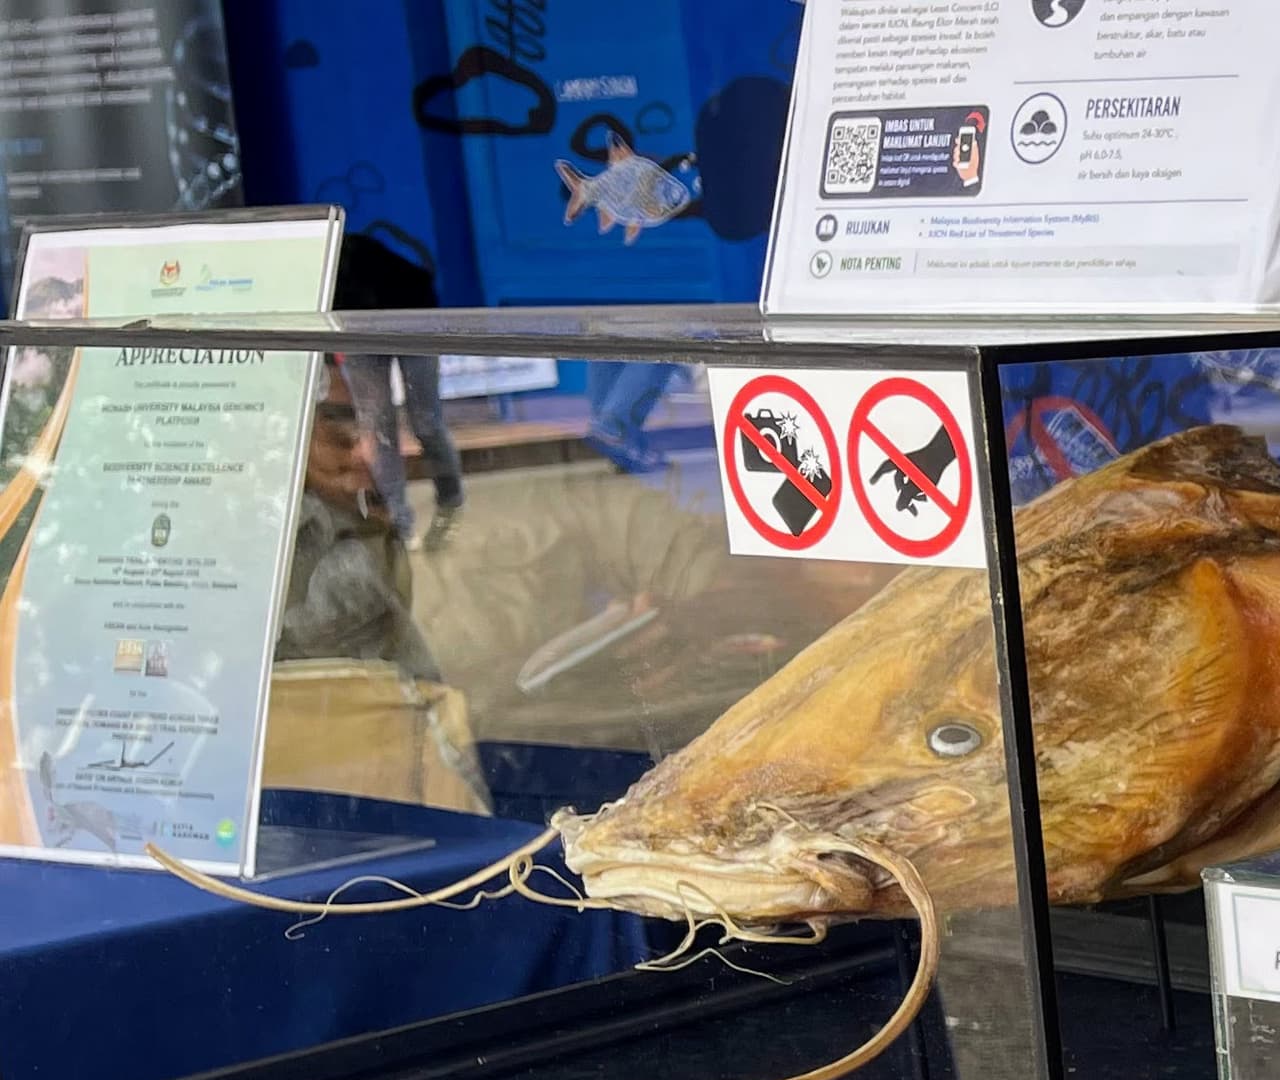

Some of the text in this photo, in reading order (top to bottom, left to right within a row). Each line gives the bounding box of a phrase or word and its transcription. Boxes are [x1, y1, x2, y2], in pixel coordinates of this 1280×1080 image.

[1100, 9, 1229, 22] dan empangan dengan kawasan
[1167, 29, 1186, 38] batu
[1188, 29, 1206, 37] atau
[1094, 51, 1134, 60] tumbuhan
[1085, 96, 1181, 120] PERSEKITARAN
[909, 118, 934, 131] UNTUK
[883, 134, 952, 149] MAKLUMAT LANJUT
[1104, 130, 1140, 142] optimum
[1114, 170, 1129, 179] dan
[1151, 168, 1182, 180] oksigen
[846, 220, 890, 235] RUJUKAN
[840, 257, 902, 271] NOTA PENTING
[116, 347, 264, 367] APPRECIATION
